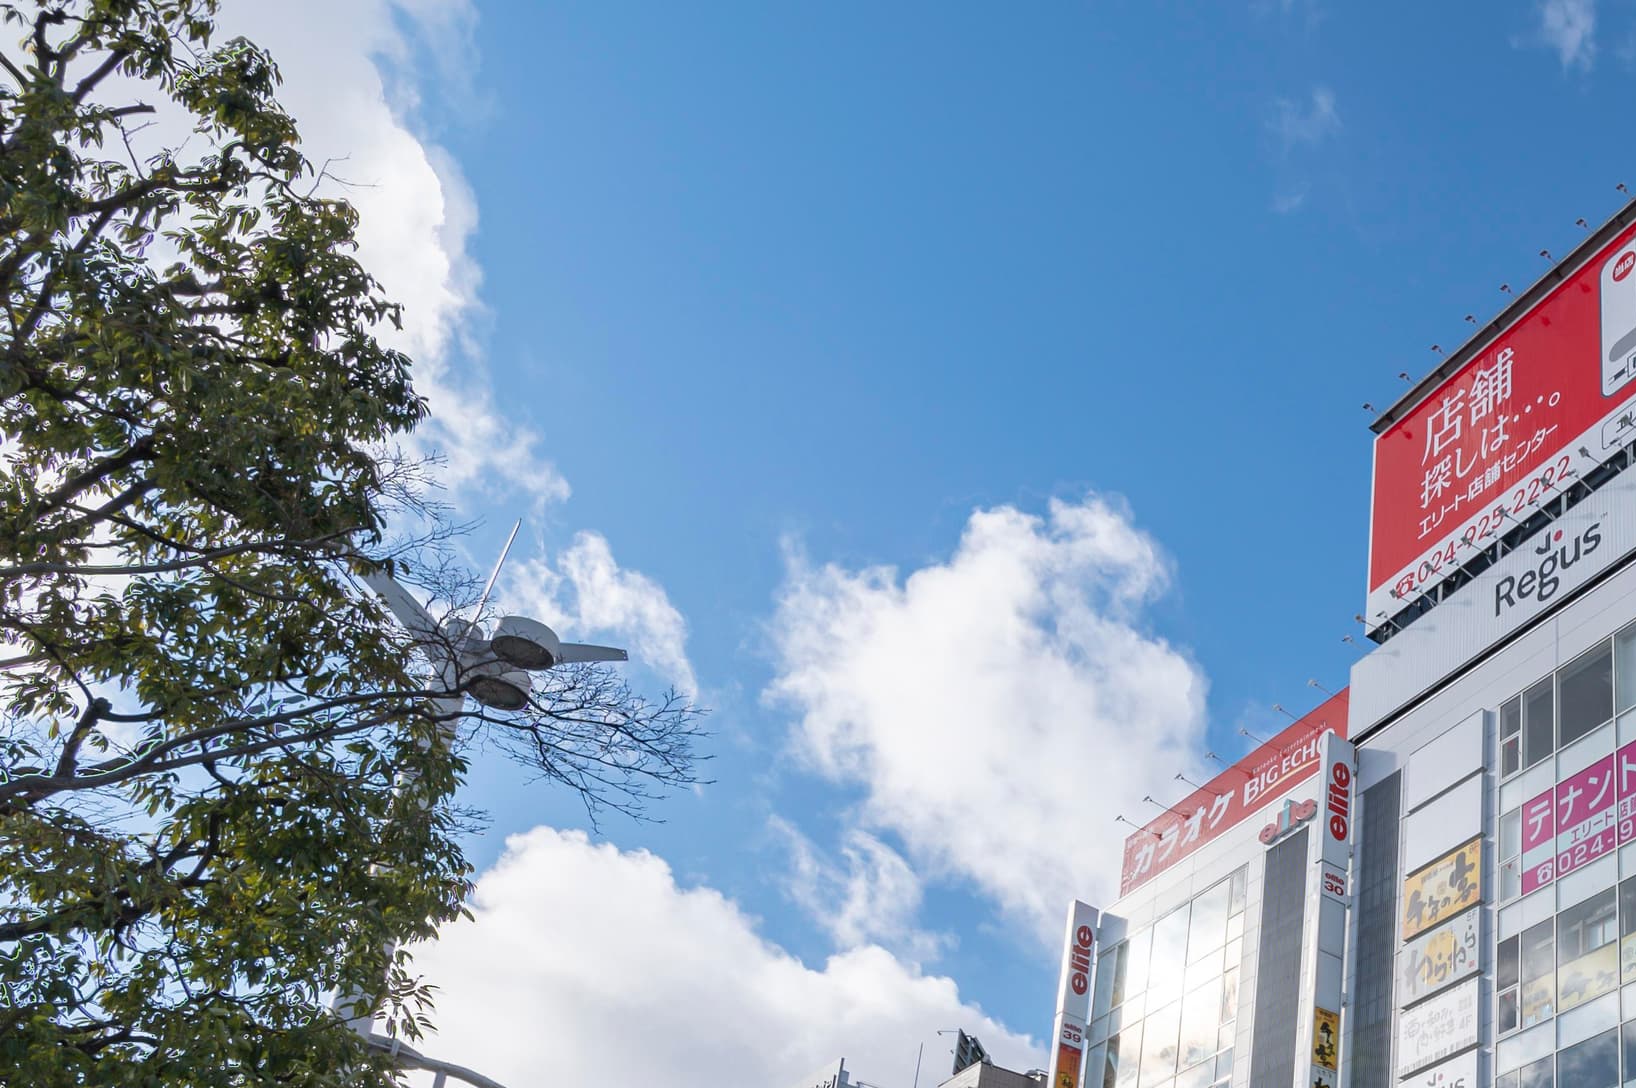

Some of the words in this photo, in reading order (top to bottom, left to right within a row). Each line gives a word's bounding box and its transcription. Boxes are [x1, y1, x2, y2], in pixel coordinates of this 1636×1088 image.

[1421, 347, 1514, 466] 店舗
[1417, 424, 1558, 539] エリート店舗センター
[1417, 455, 1570, 584] 024-925-2222
[1495, 522, 1601, 617] Regus
[1243, 765, 1279, 807] BIG
[1329, 762, 1350, 841] elite
[1132, 789, 1235, 880] カラオケ
[1324, 880, 1344, 896] 30
[1071, 924, 1093, 996] elite
[1404, 925, 1476, 995] わらわら
[1063, 1030, 1082, 1044] 39
